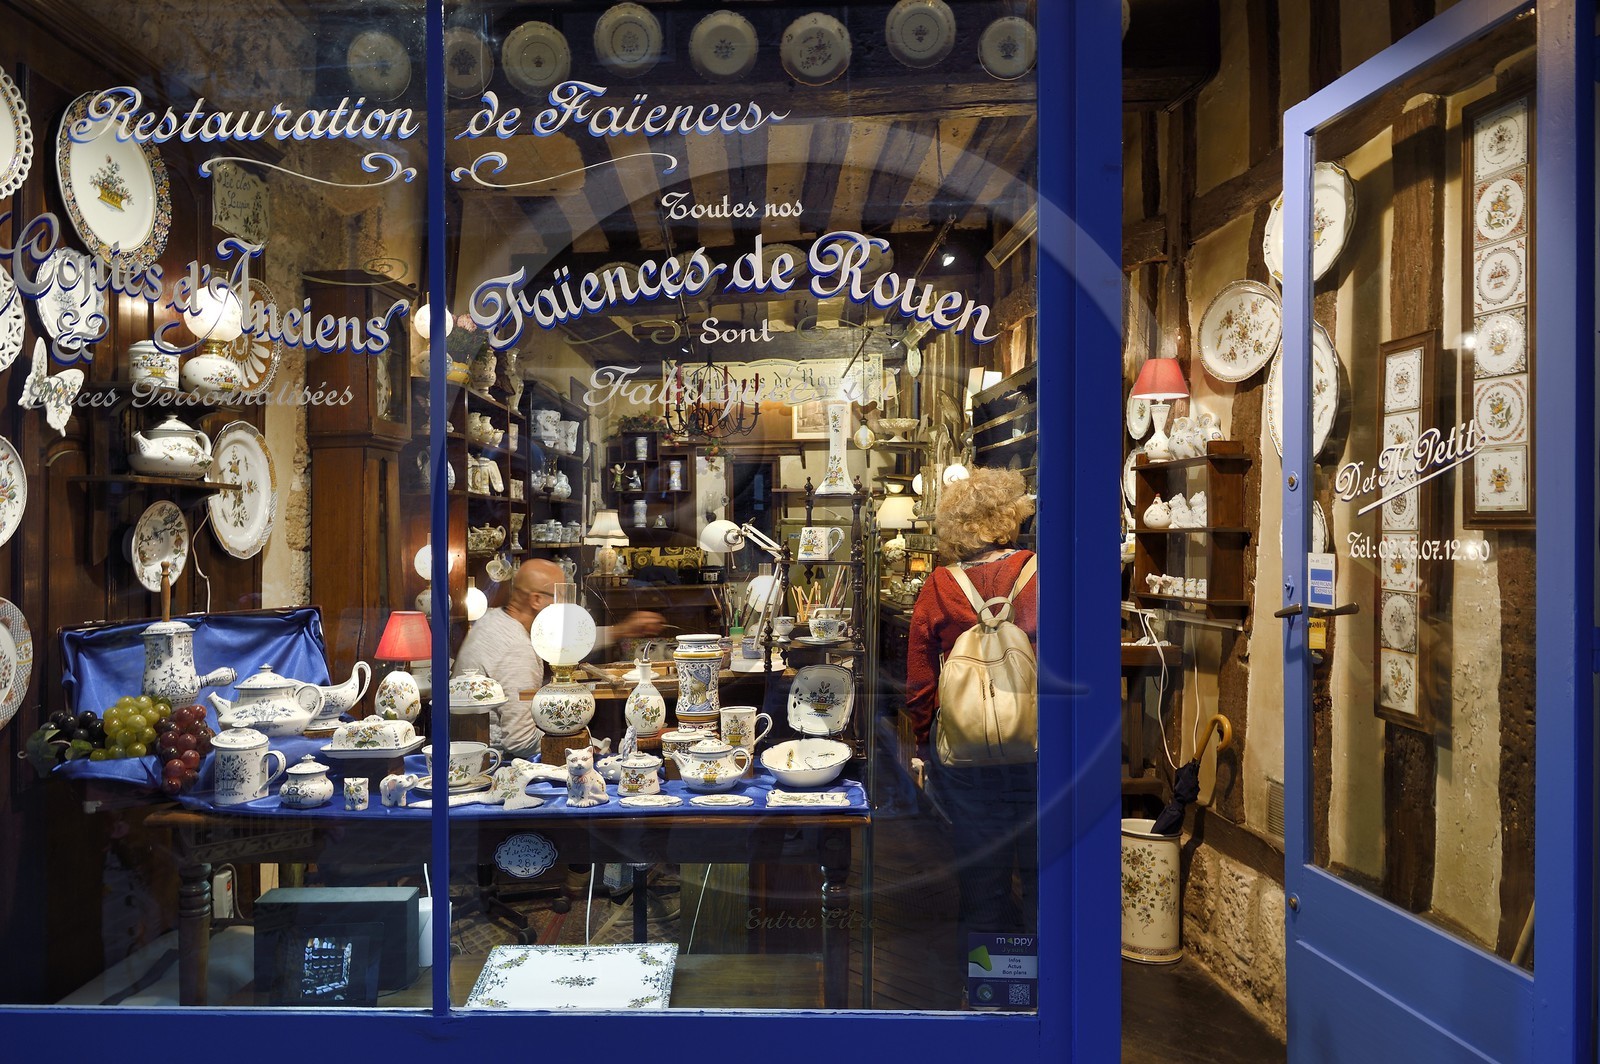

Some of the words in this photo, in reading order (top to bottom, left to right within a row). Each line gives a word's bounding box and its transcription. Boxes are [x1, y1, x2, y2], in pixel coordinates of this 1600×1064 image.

[68, 86, 420, 144] Restauration
[454, 91, 522, 139] de
[532, 80, 791, 138] Faïences
[661, 192, 757, 220] Toutes
[765, 199, 804, 218] nos
[0, 212, 165, 315] Copies
[469, 246, 726, 352] Faïences
[725, 234, 795, 295] de
[808, 231, 1000, 345] Rouen
[52, 310, 110, 366] &
[700, 316, 775, 345] Sont
[131, 379, 354, 409] Personnalisées
[1362, 467, 1376, 494] et
[1413, 419, 1476, 475] Petit
[746, 907, 816, 930] Entrée
[996, 937, 1033, 946] mappy
